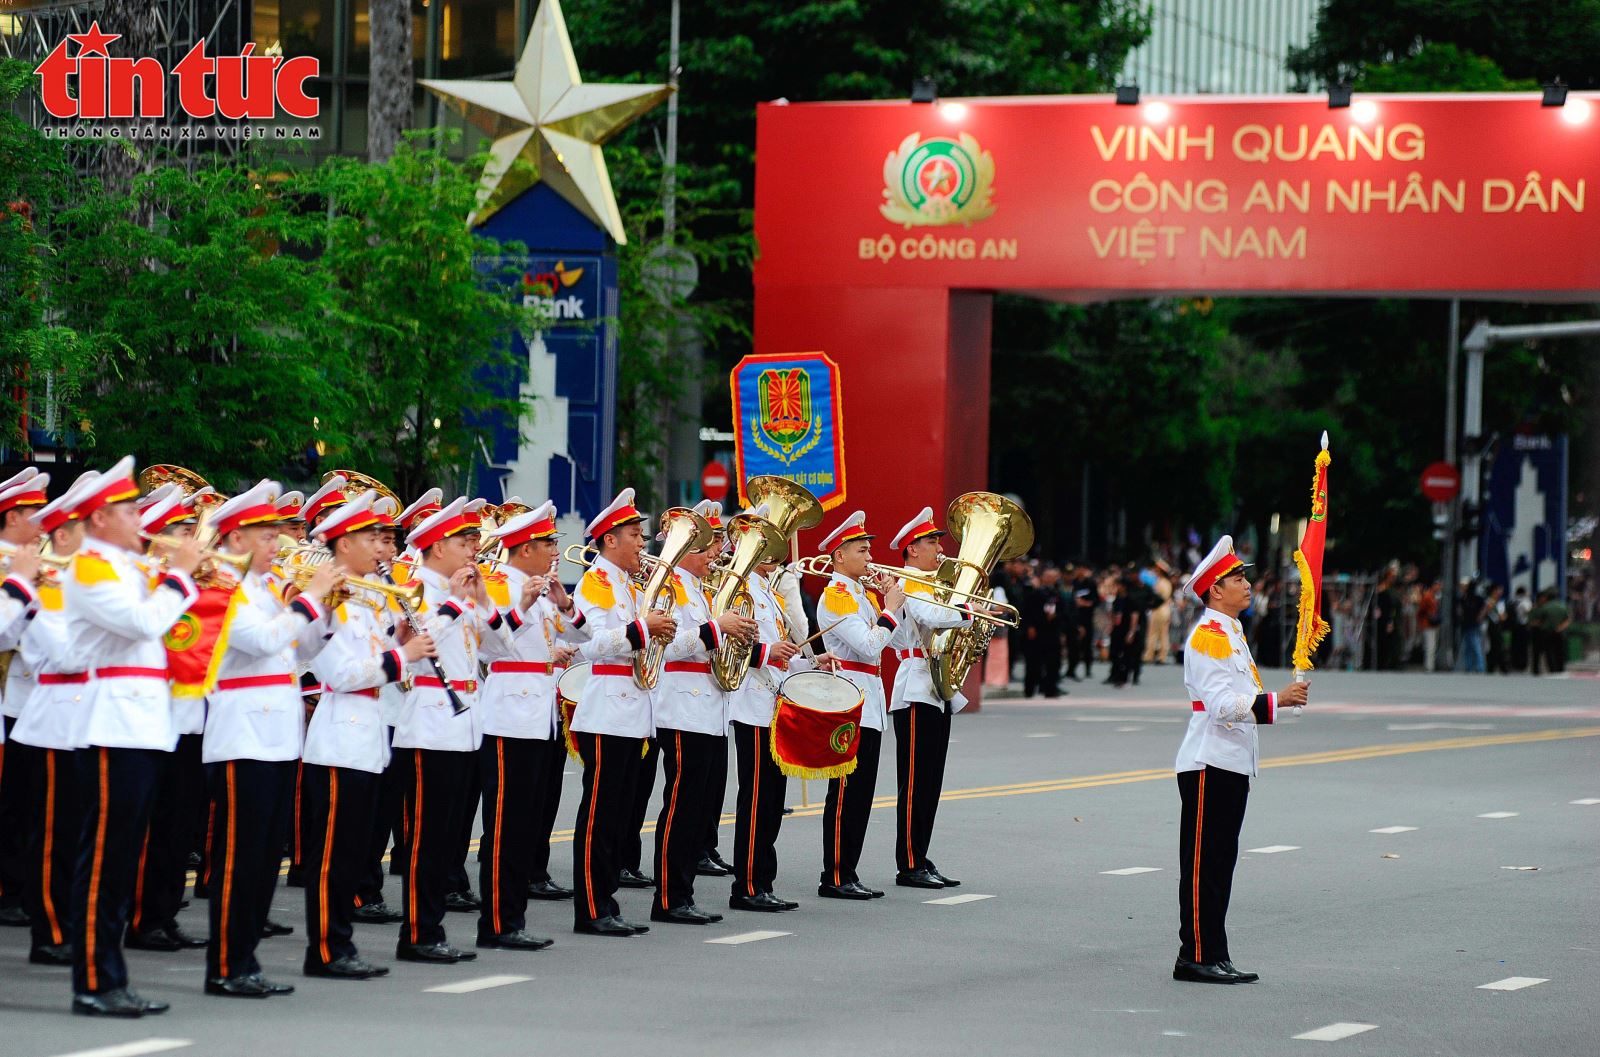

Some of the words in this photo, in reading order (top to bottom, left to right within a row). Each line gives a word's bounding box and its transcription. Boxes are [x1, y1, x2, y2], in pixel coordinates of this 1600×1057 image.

[1090, 124, 1215, 162] VINH
[1231, 123, 1426, 164] QUANG
[1088, 172, 1229, 214] CÔNG
[1243, 180, 1311, 213] AN
[1326, 170, 1465, 214] NHÂN
[1482, 170, 1586, 213] DÂN
[858, 234, 897, 264] BỘ
[900, 233, 976, 260] CÔNG
[980, 238, 1019, 260] AN
[1087, 217, 1185, 267] VIỆT
[1200, 227, 1307, 260] NAM
[523, 295, 585, 319] Bank
